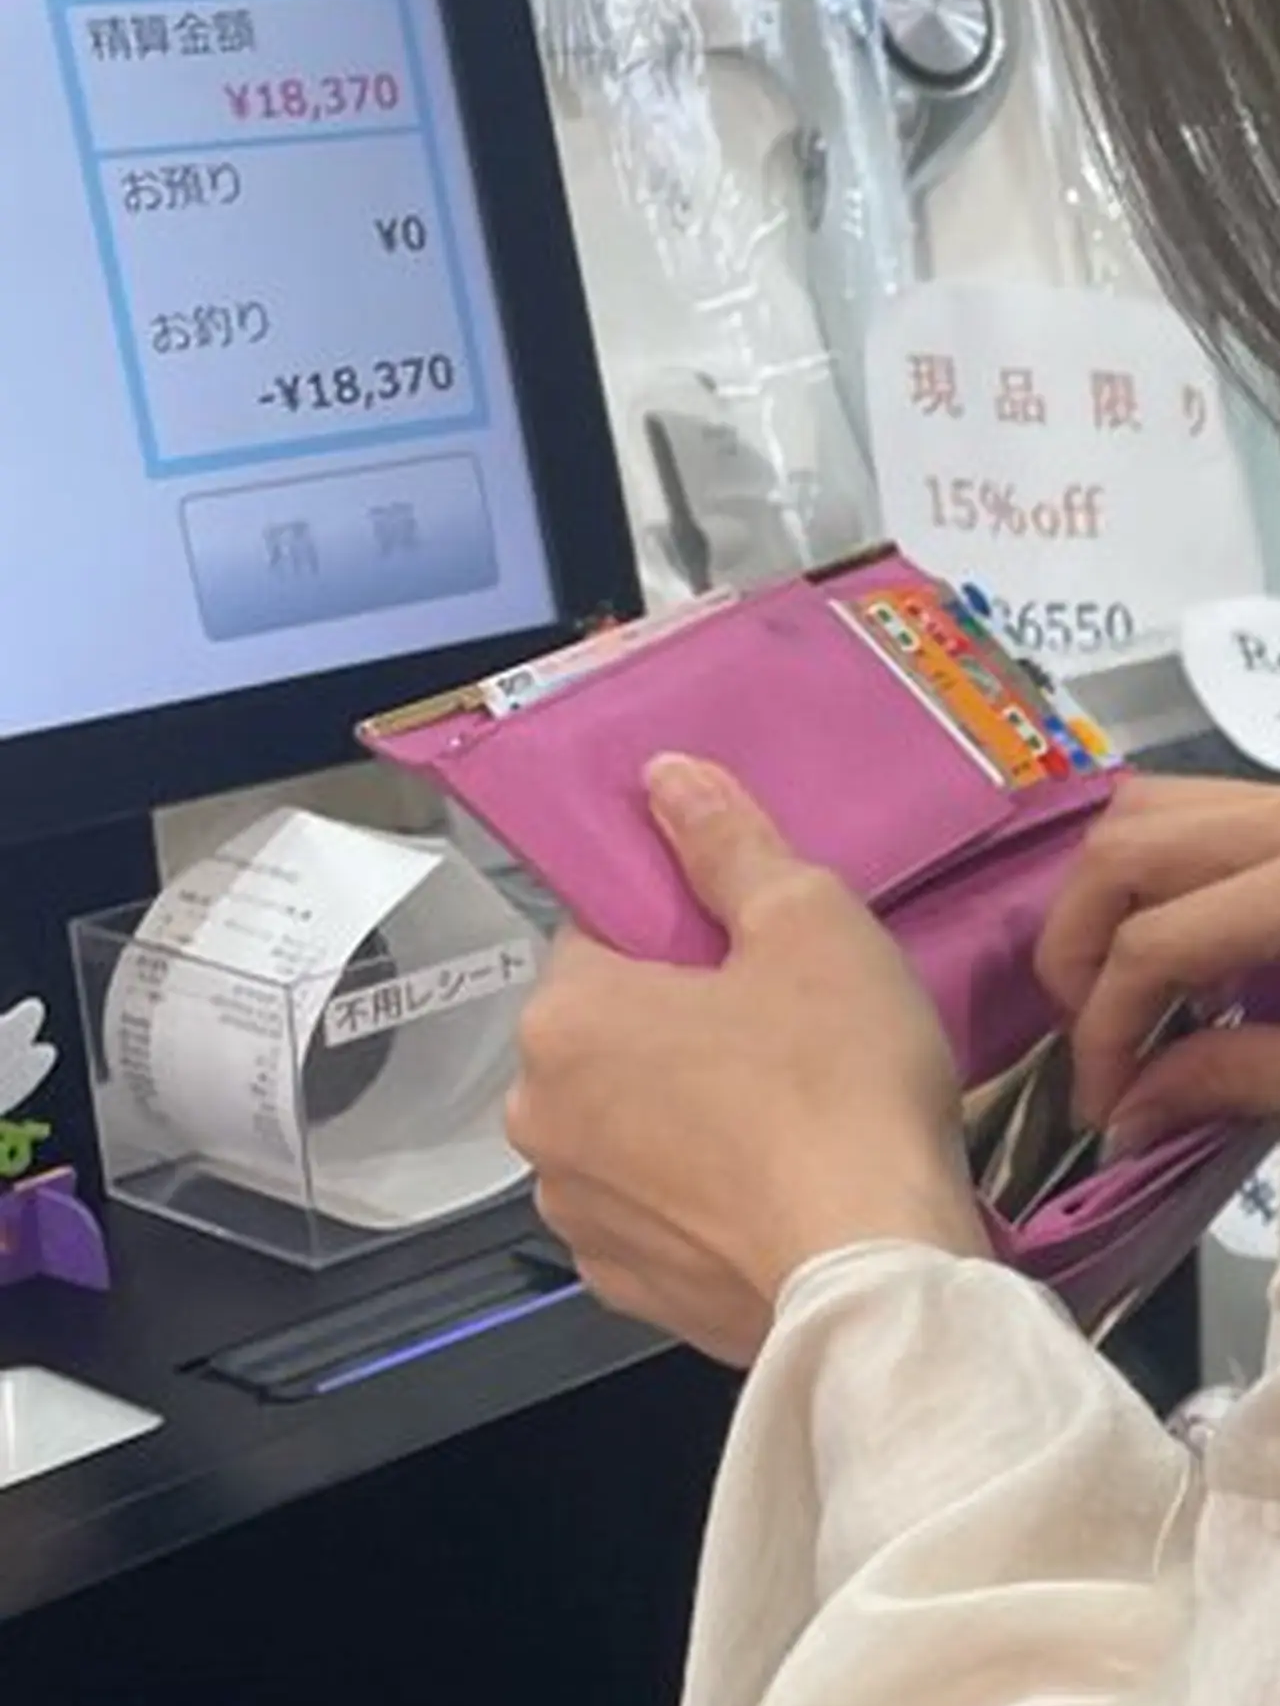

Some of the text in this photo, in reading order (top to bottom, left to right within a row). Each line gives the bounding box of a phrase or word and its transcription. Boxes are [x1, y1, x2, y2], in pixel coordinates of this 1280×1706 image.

[88, 10, 255, 60] 精算金額
[225, 72, 399, 121] ¥18,370
[122, 162, 241, 212] お預り
[375, 216, 426, 253] ¥0
[151, 301, 269, 353] お釣り
[258, 353, 454, 411] -¥18,370
[908, 354, 1207, 436] 現品限り
[925, 473, 1104, 539] 15%off
[334, 951, 526, 1033] 不用レシート
